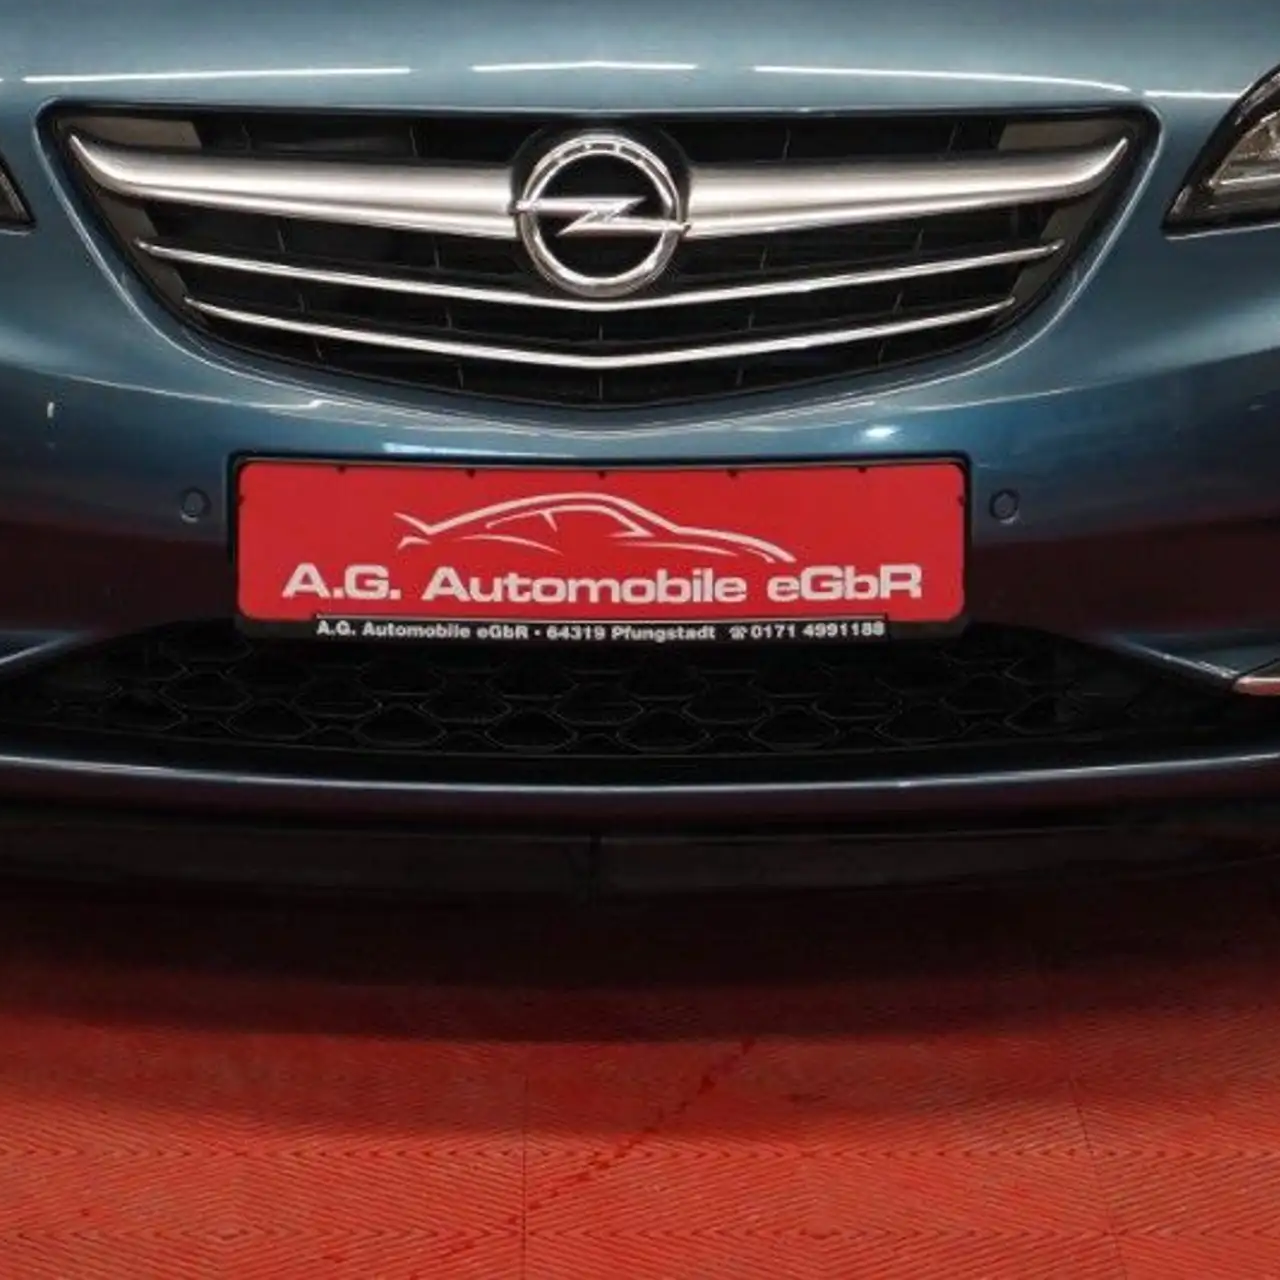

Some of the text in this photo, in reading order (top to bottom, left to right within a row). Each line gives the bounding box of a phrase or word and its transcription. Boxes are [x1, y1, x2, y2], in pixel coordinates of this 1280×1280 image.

[282, 562, 923, 604] A.G. Automobile eGbR
[316, 620, 356, 636] A.G.
[362, 621, 470, 639] Automobile
[476, 624, 529, 640] eGbR
[546, 624, 606, 641] 64319
[610, 625, 716, 643] Pfungstadt
[750, 624, 796, 639] 0171
